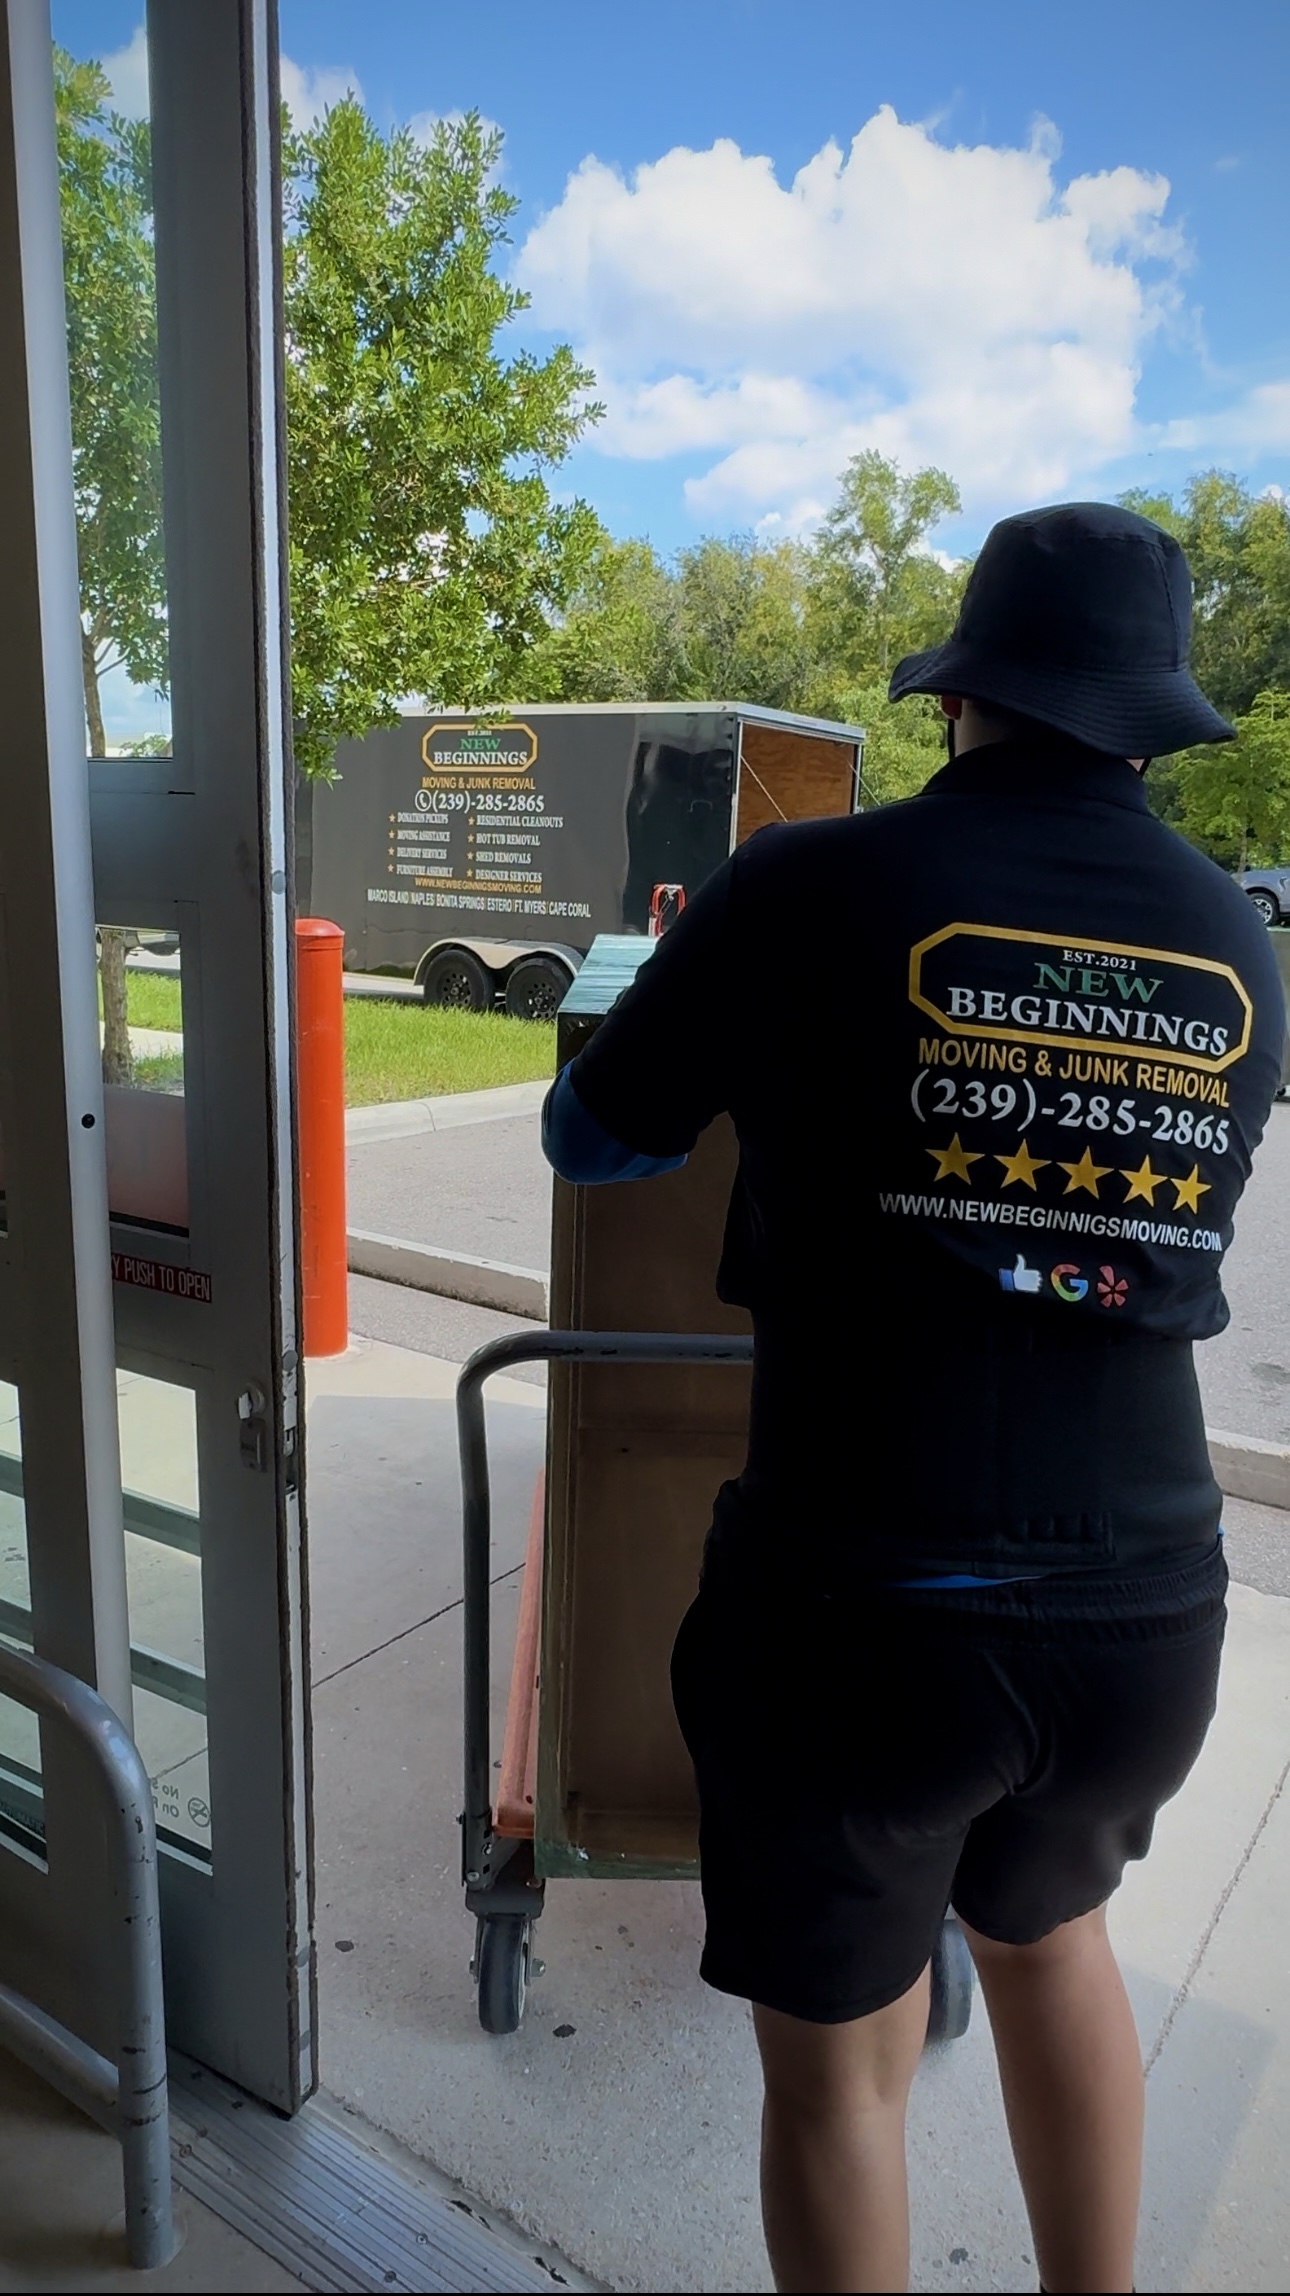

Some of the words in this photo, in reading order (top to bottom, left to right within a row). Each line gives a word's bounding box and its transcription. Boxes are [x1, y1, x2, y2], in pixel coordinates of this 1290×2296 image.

[460, 738, 501, 750] NEW
[433, 751, 528, 765] BEGINNINGS
[422, 776, 457, 789] MOVING
[458, 777, 465, 789] &
[466, 777, 491, 789] JUNK
[492, 778, 536, 790] REMOVAL
[432, 790, 545, 814] (239)-285-2865
[476, 815, 521, 827] RESIDENTIAL
[521, 816, 564, 828] CLEANOUTS
[476, 833, 491, 844] HOT
[491, 834, 506, 845] TUB
[506, 834, 541, 846] REMOVAL
[475, 851, 494, 862] SHED
[494, 852, 532, 864] REMOVALS
[475, 869, 509, 881] DESIGNER
[509, 870, 543, 883] SERVICES
[367, 889, 388, 902] MARCO
[388, 890, 409, 904] ISLAND
[411, 892, 435, 906] NAPLES
[436, 894, 457, 908] BONITA
[458, 896, 485, 910] SPRINGS
[487, 898, 512, 912] ESTERO
[524, 900, 547, 914] MYERS
[548, 902, 568, 916] CAPE
[567, 902, 592, 918] CORAL
[1062, 949, 1137, 971] EST.2021
[1032, 962, 1164, 1004] NEW
[945, 987, 1229, 1056] BEGINNINGS
[918, 1037, 1027, 1074] MOVING
[1034, 1050, 1052, 1077] &
[1059, 1053, 1129, 1088] JUNK
[1135, 1063, 1230, 1108] REMOVAL
[910, 1068, 1230, 1155] (239)-285-2865
[878, 1192, 1223, 1252] WWW.NEWBEGINNIGSMOVING.COM
[124, 1258, 155, 1287] PUSH
[158, 1266, 174, 1292] TO
[178, 1271, 211, 1301] OPEN
[1050, 1263, 1089, 1302] G
